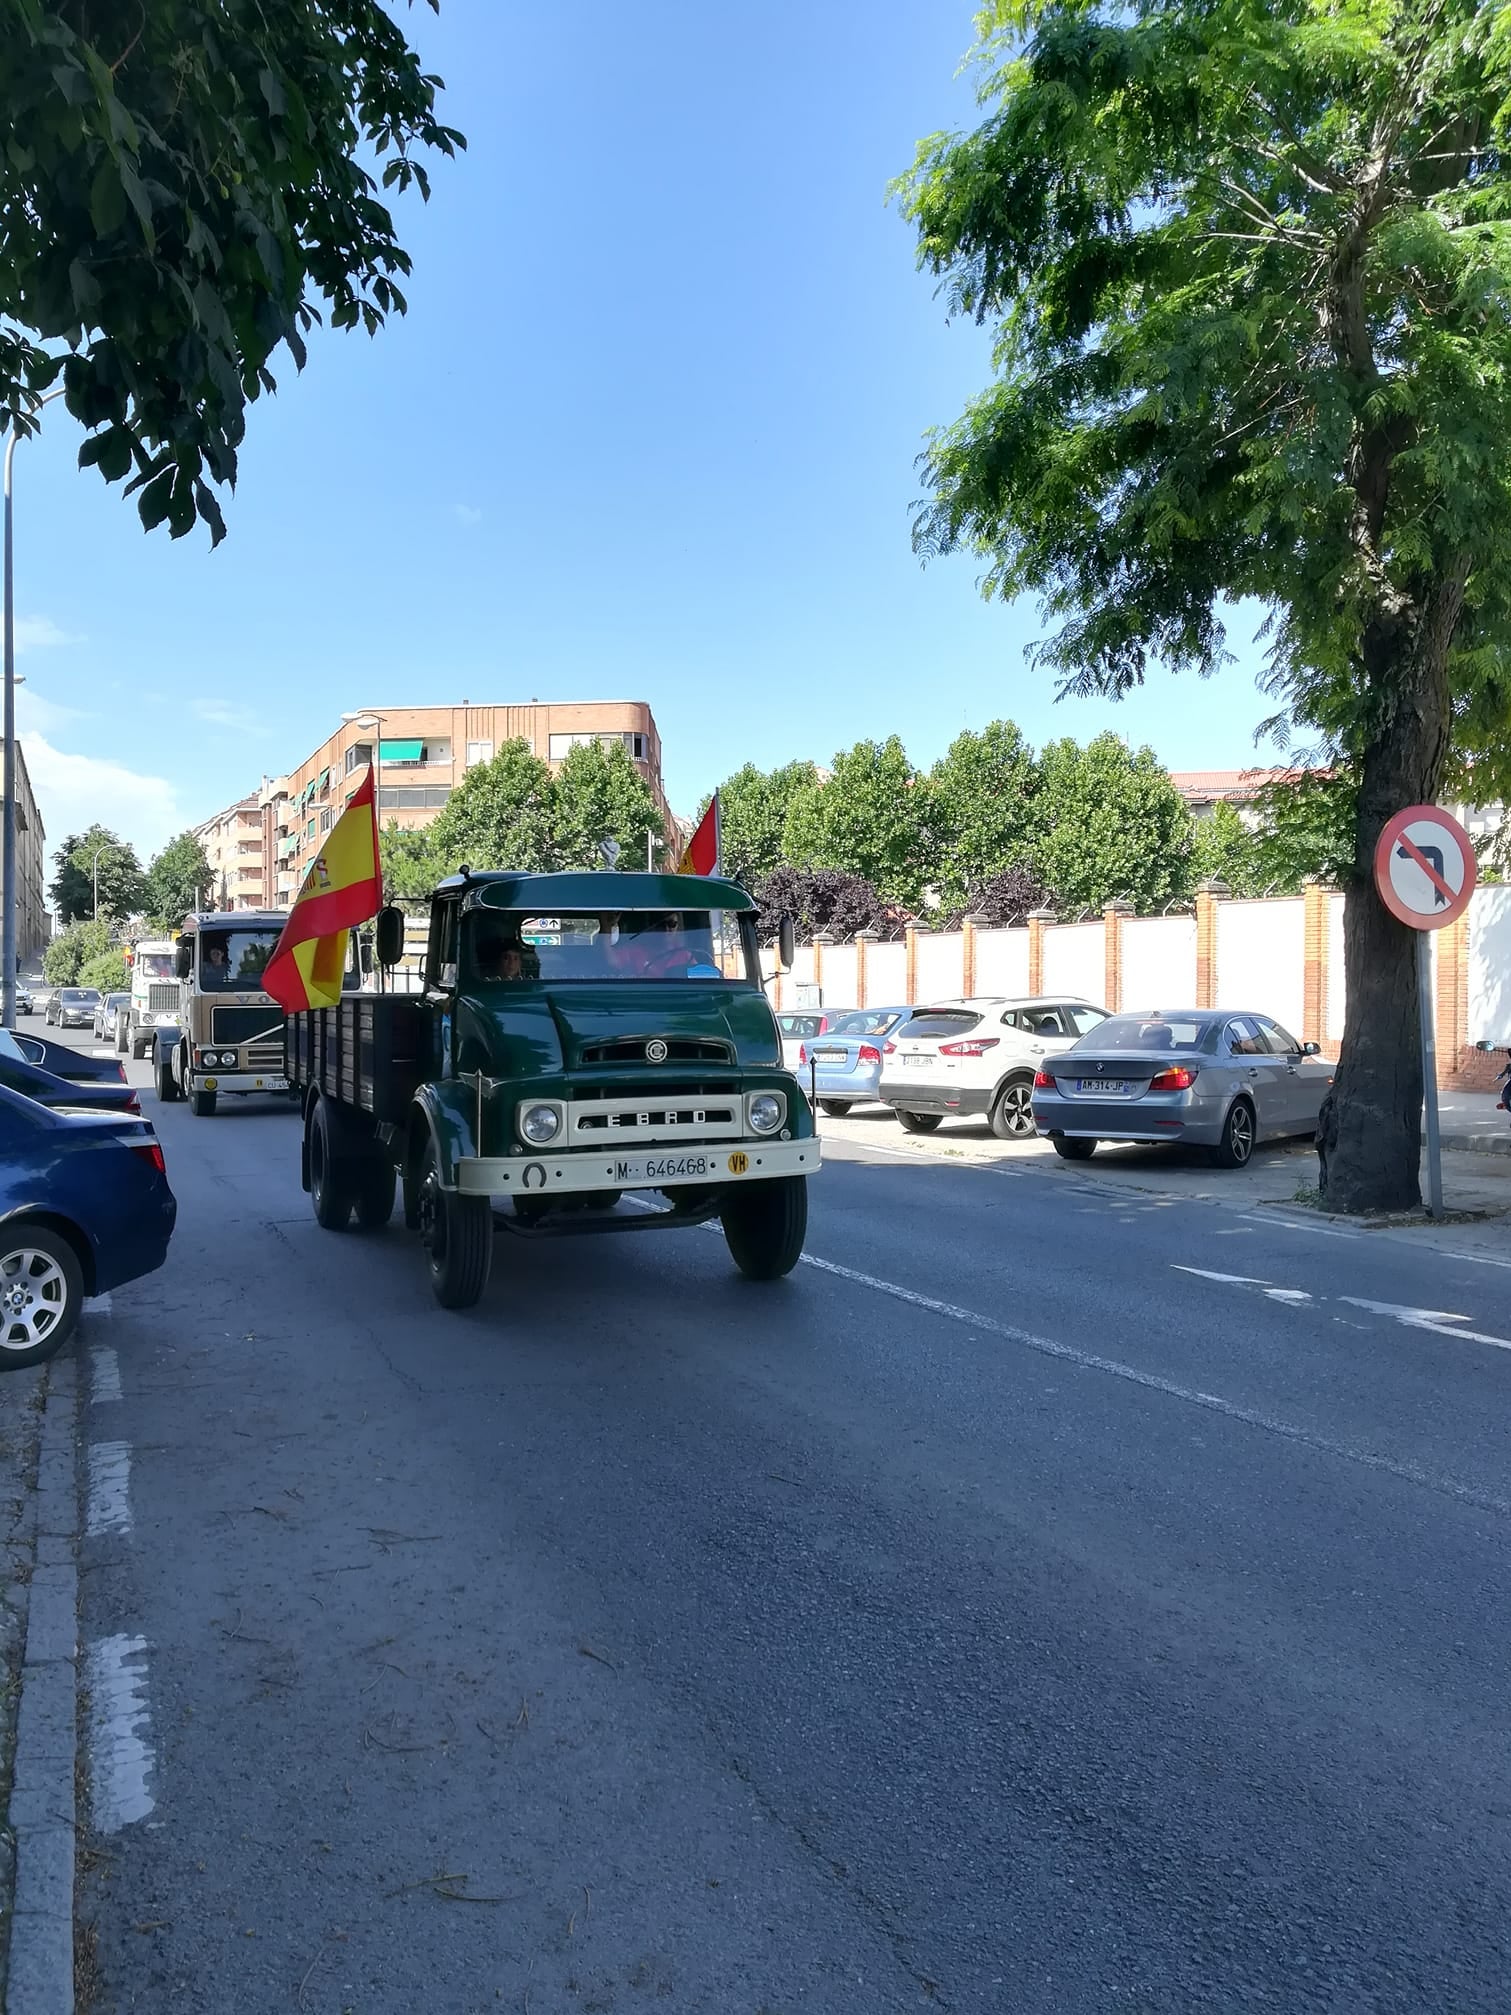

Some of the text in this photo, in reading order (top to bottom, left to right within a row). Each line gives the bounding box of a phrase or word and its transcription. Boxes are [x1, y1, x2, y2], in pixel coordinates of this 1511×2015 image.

[607, 1110, 706, 1127] EBRO
[646, 1157, 706, 1177] 646468
[731, 1154, 746, 1172] VH
